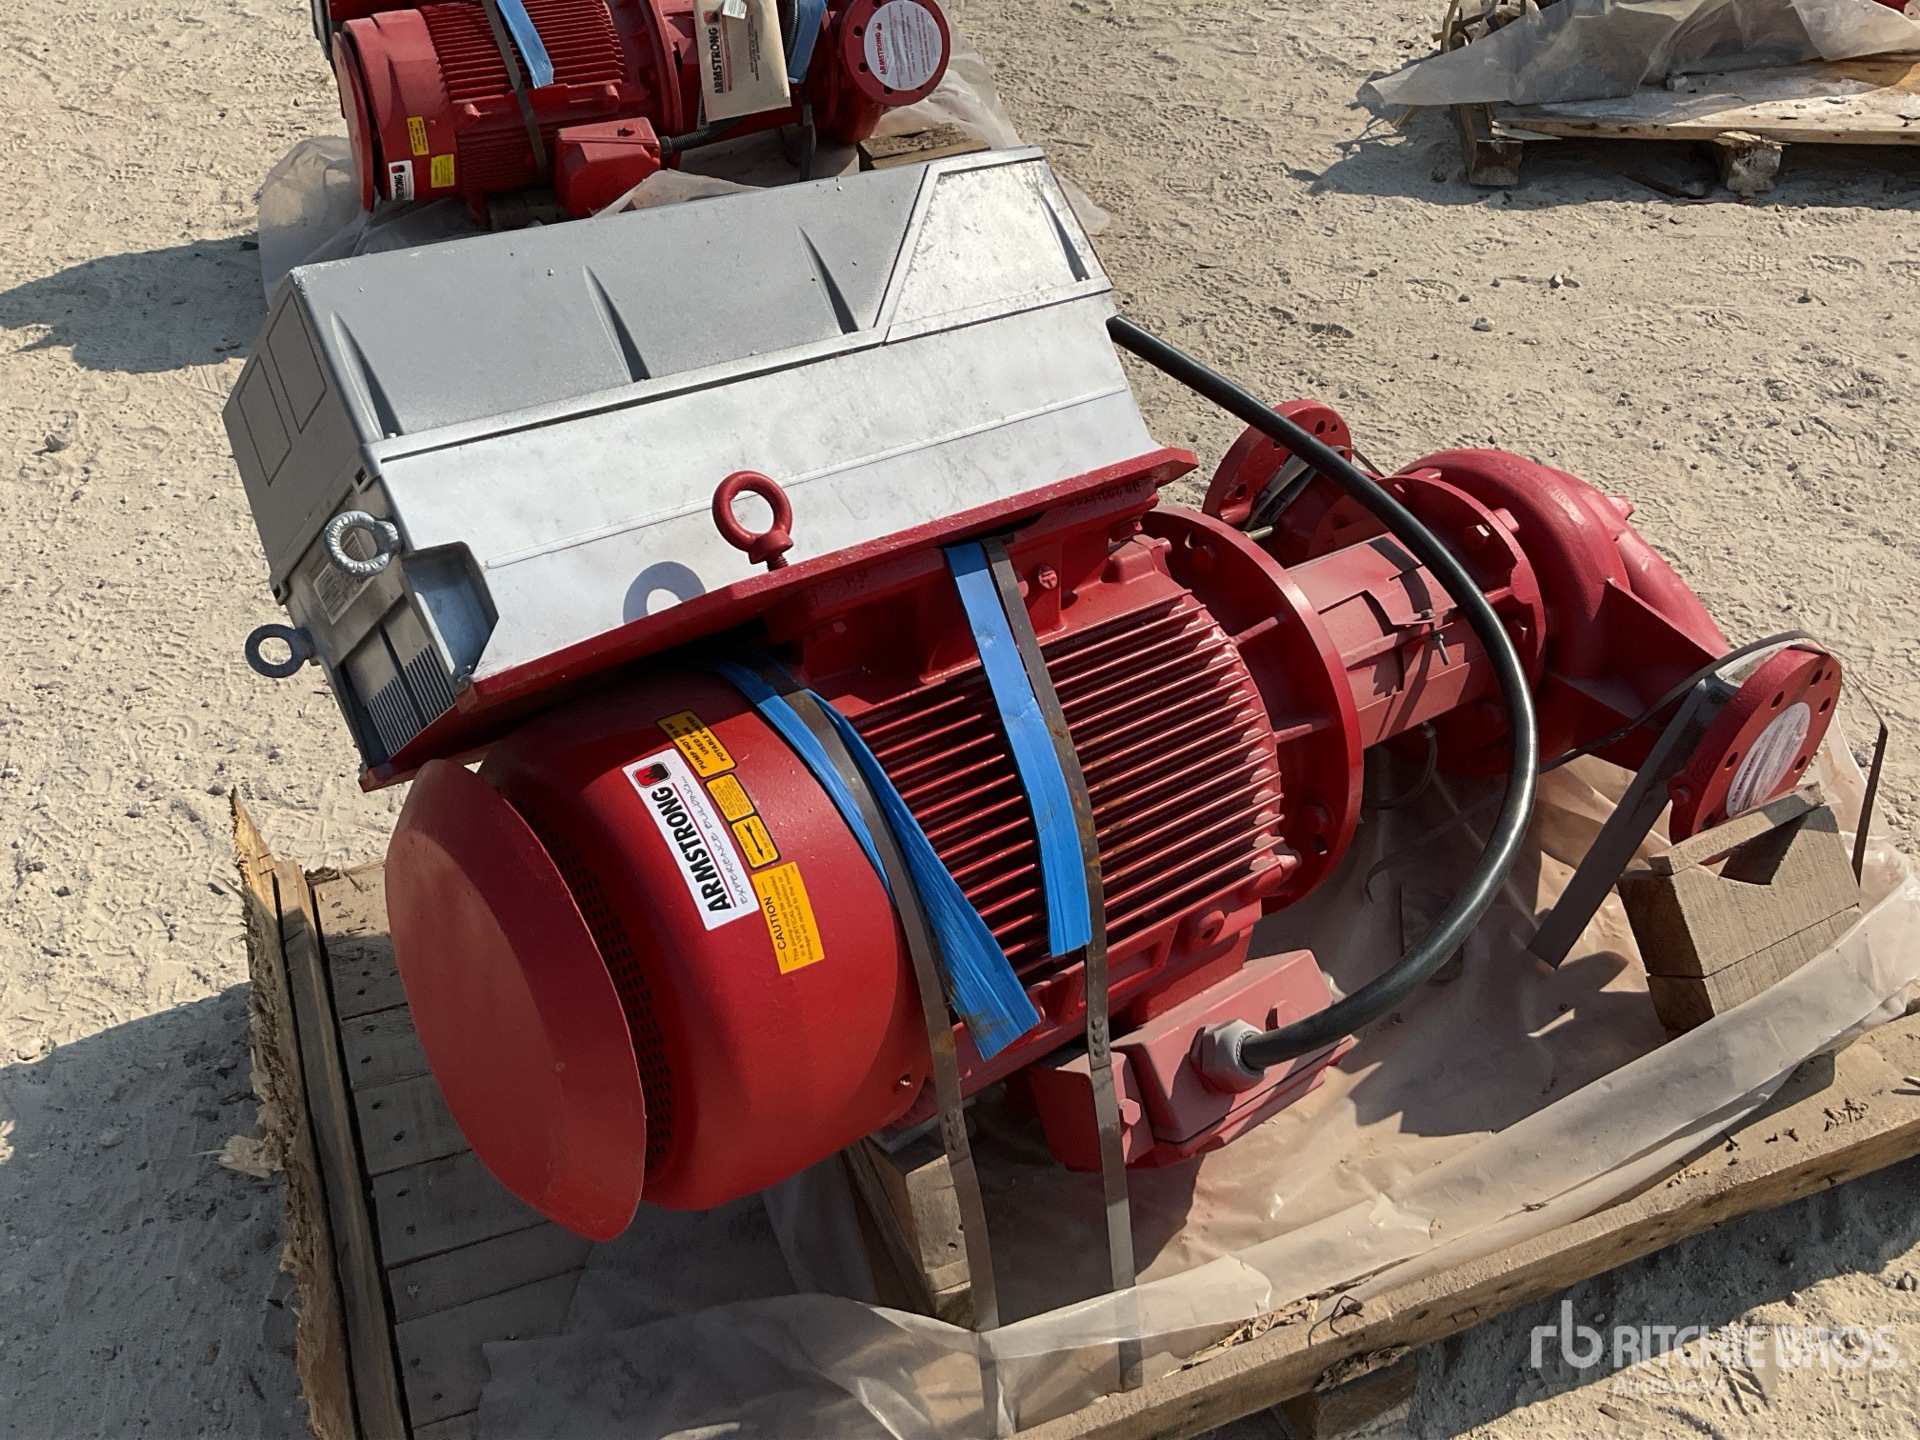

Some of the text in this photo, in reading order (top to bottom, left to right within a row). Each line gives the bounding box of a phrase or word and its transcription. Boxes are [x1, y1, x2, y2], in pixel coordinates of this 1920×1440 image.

[708, 27, 723, 93] ARMSTRONG
[874, 32, 887, 74] ARMSTRONG
[685, 715, 704, 734] WATER
[679, 738, 692, 750] NOT
[682, 726, 709, 755] USED FOR
[702, 734, 726, 762] POTABLE
[690, 751, 707, 770] PUMP
[651, 785, 732, 913] ARMSTRONG
[708, 831, 749, 904] EXPERIENCE
[781, 867, 791, 885] motor
[780, 883, 792, 908] position
[787, 886, 795, 896] the
[762, 895, 787, 950] CAUTION
[768, 875, 800, 960] This pump must be installed
[788, 910, 802, 943] VERTICAL
[793, 904, 803, 922] result
[803, 934, 815, 960] damage
